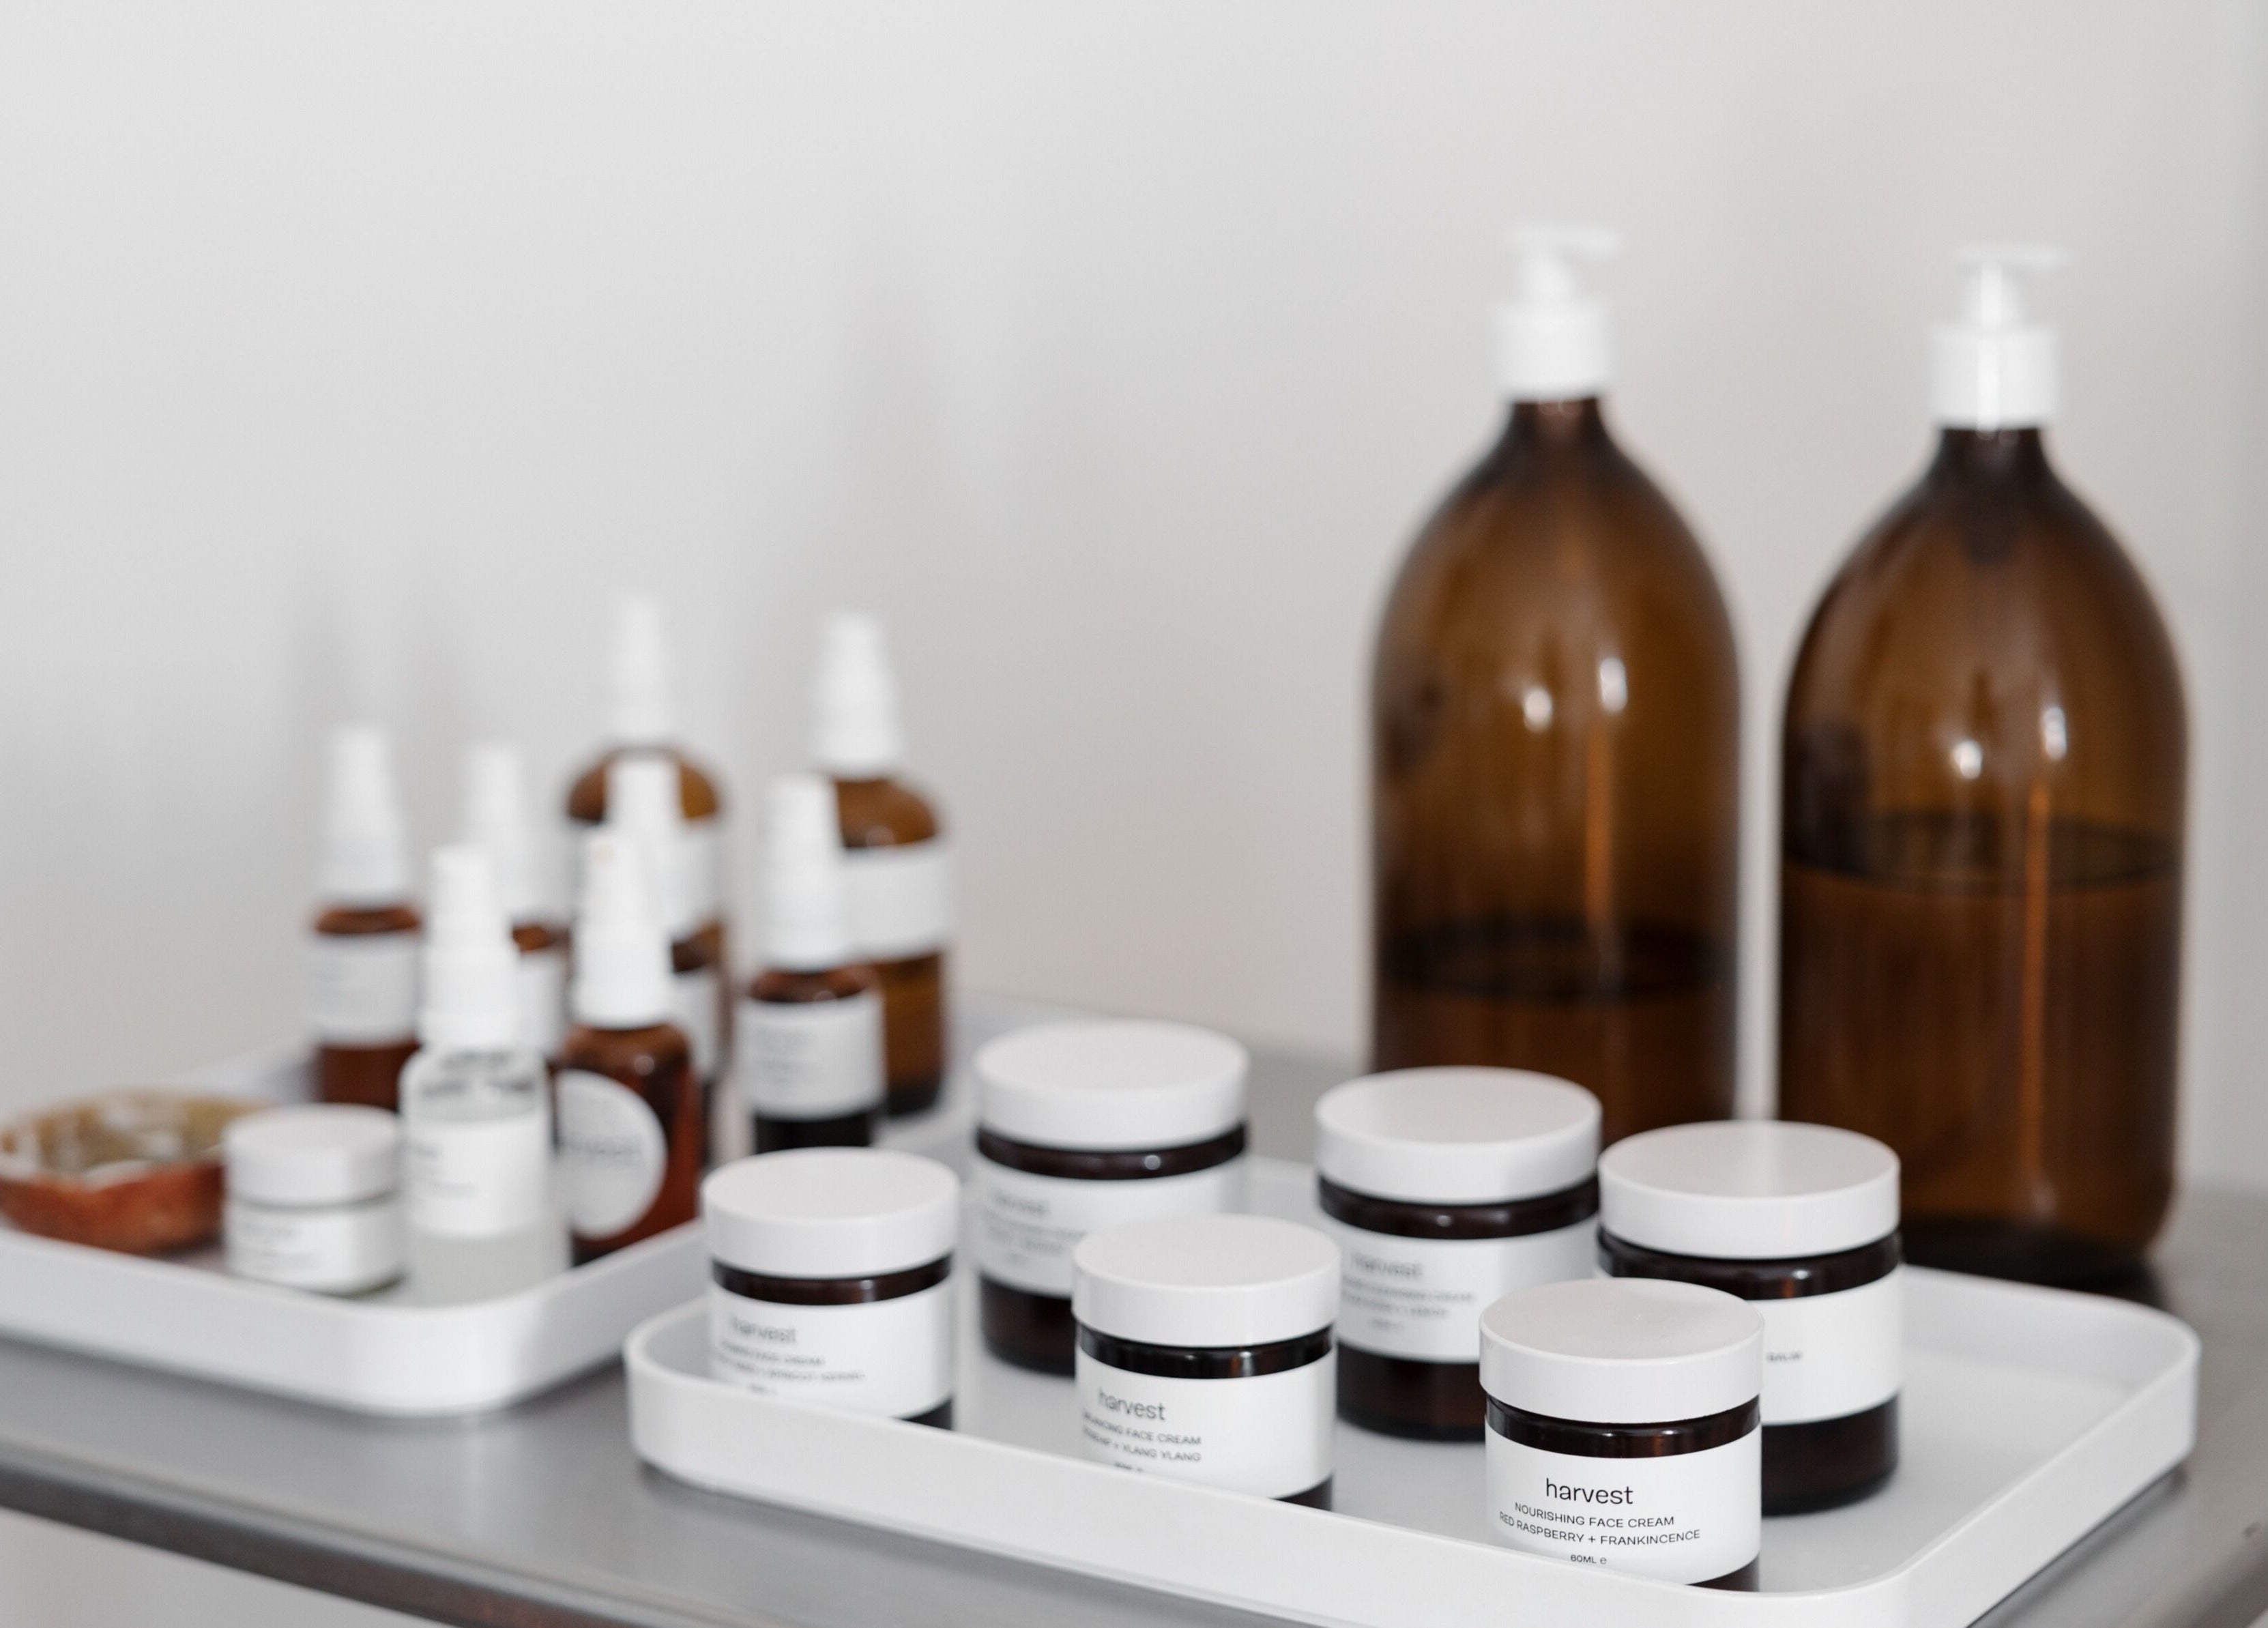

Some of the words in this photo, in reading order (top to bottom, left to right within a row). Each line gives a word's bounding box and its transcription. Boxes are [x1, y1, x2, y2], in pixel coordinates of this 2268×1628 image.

[1098, 1386, 1166, 1421] harvest
[1126, 1427, 1154, 1441] FACE
[1156, 1432, 1202, 1445] CREAM
[1122, 1442, 1157, 1458] YLANG
[1161, 1449, 1202, 1462] YLANG
[1545, 1477, 1633, 1505] harvest
[1500, 1511, 1515, 1526] RED
[1517, 1520, 1584, 1543] RASPBERRY
[1588, 1535, 1596, 1543] +
[1600, 1529, 1700, 1545] FRANKINCENCE
[1515, 1502, 1585, 1526] NOURISHING
[1589, 1517, 1623, 1528] FACE
[1628, 1516, 1674, 1528] CREAM
